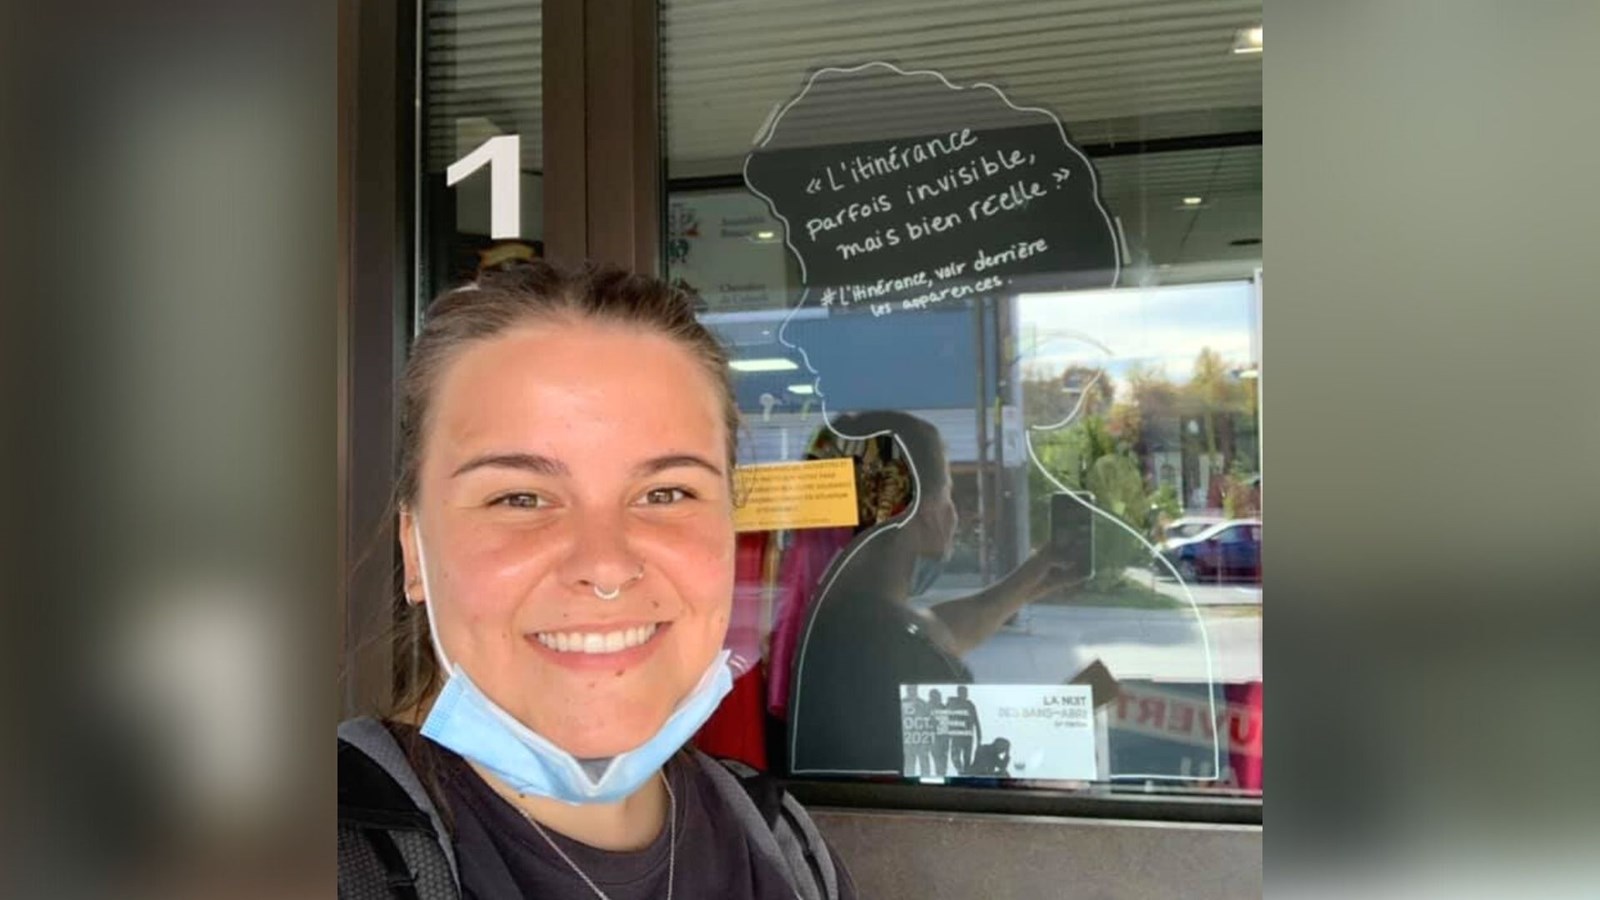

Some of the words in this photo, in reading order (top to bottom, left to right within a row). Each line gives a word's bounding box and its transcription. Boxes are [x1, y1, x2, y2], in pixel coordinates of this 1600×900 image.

[446, 134, 520, 240] 1
[805, 194, 892, 242] parfois
[906, 149, 1036, 205] invisible,
[836, 228, 900, 260] mais
[905, 211, 962, 240] bien
[934, 262, 967, 280] voir
[973, 238, 1048, 272] derrière
[870, 303, 892, 317] les
[1043, 695, 1060, 706] LA
[1062, 695, 1087, 706] NUIT
[904, 732, 936, 745] 2021
